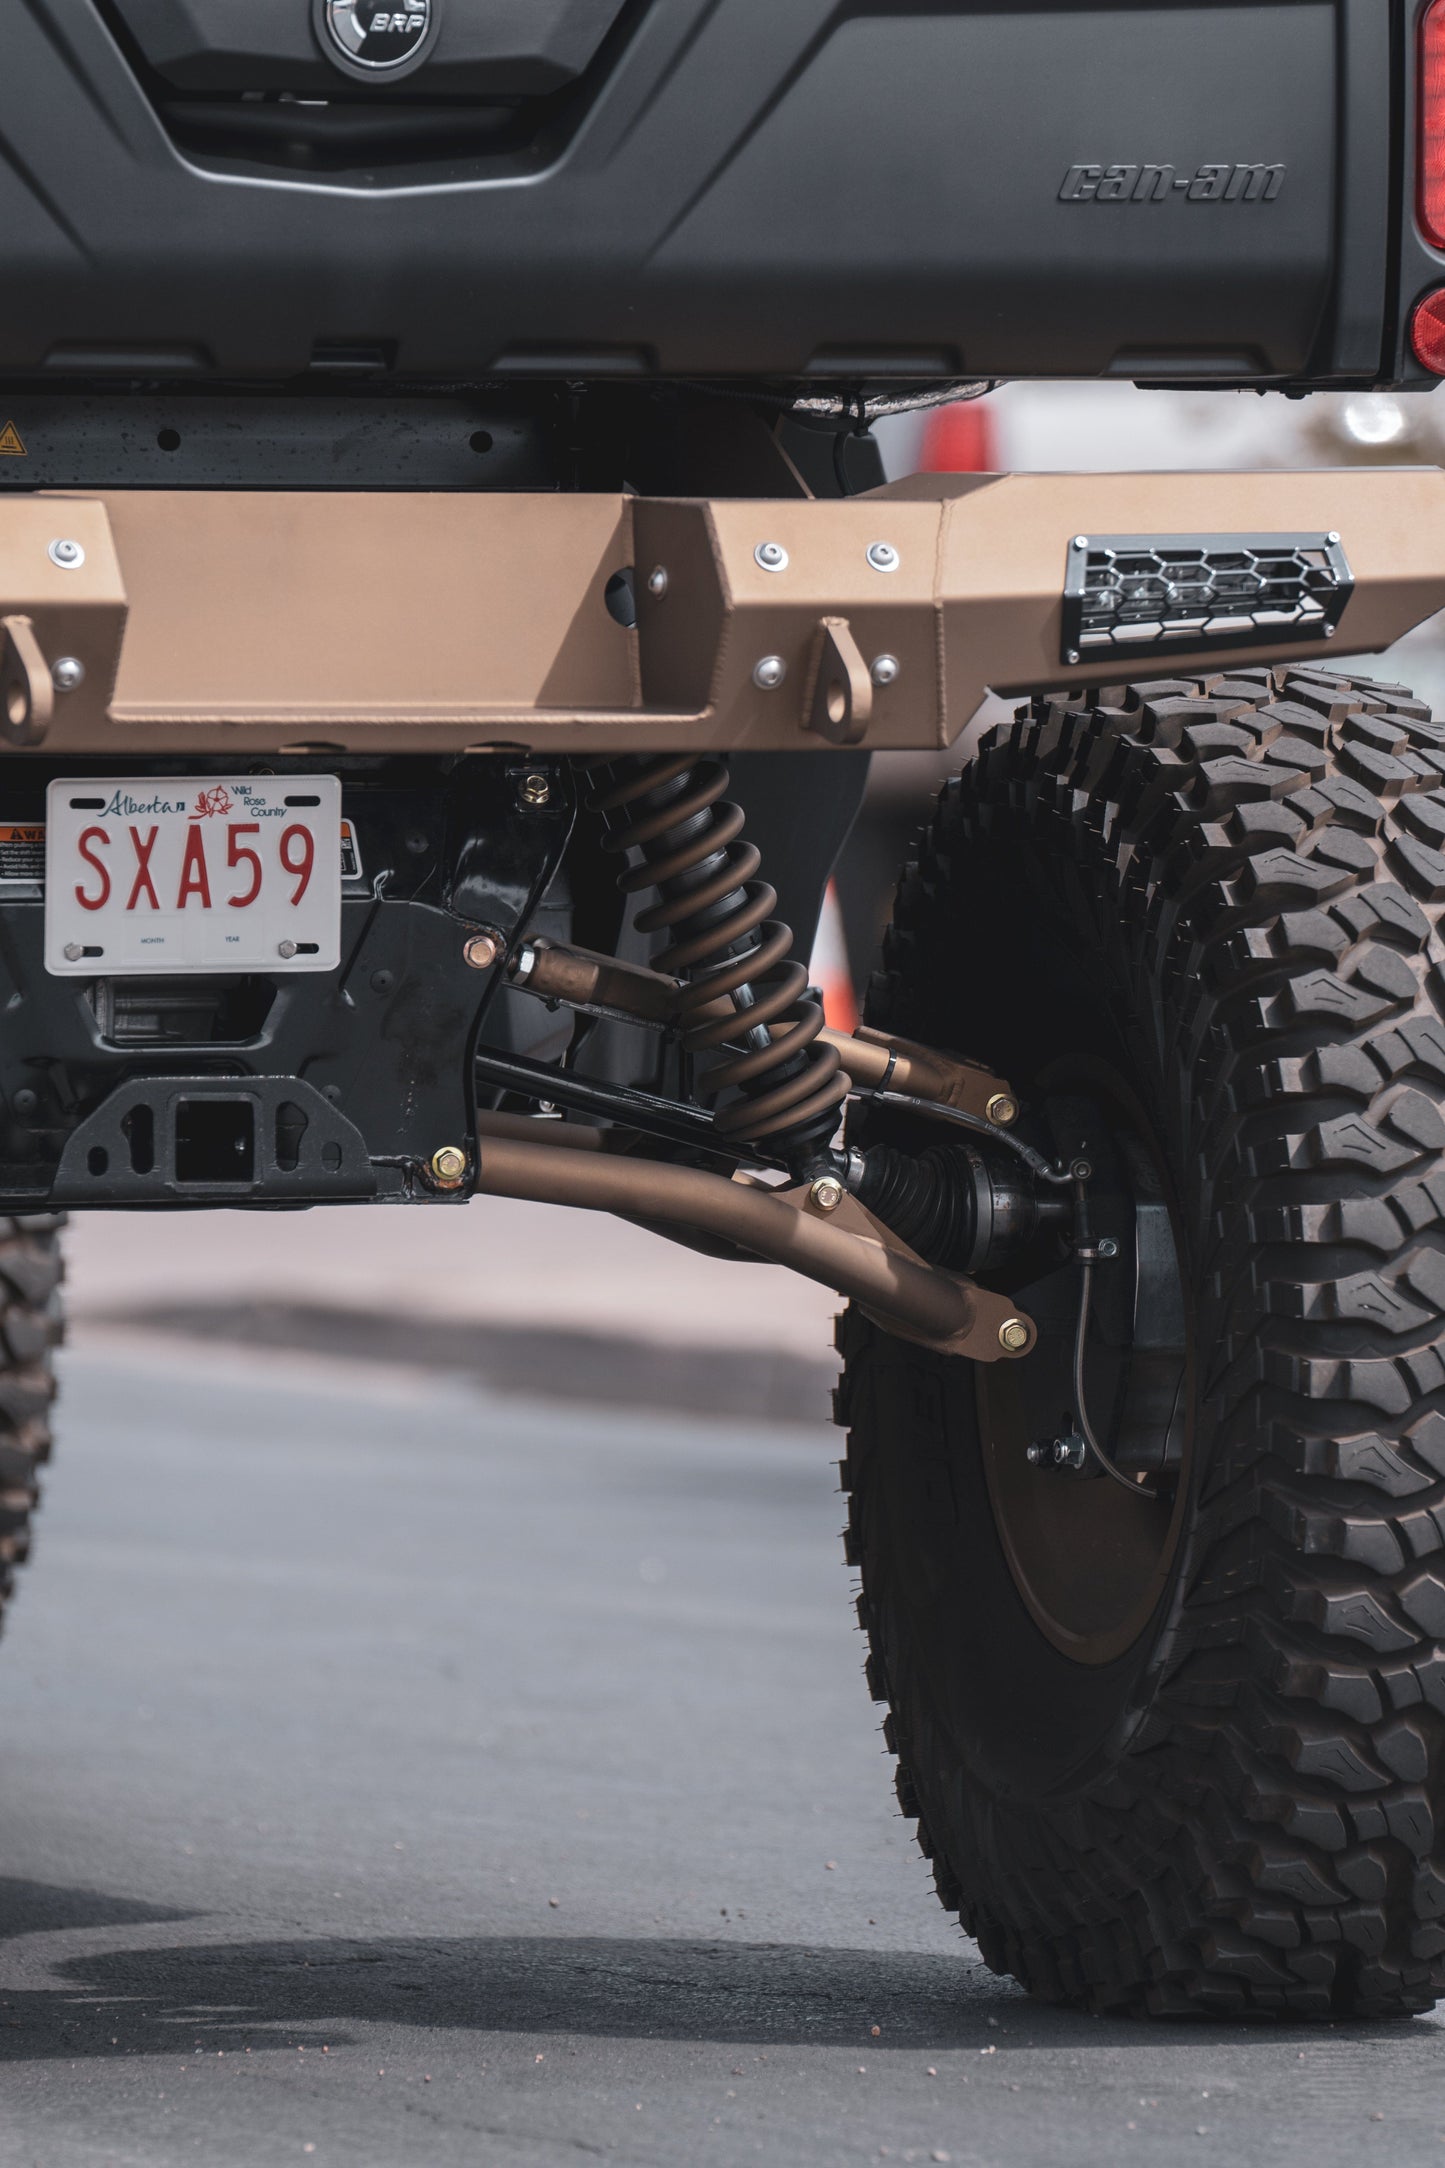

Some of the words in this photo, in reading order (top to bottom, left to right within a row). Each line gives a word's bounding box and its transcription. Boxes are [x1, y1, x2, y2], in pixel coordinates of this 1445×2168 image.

[369, 12, 425, 33] BRP
[231, 785, 253, 796] Wild
[97, 789, 176, 817] Alberta
[243, 797, 267, 806] Rose
[250, 806, 288, 818] Country
[74, 822, 315, 912] SXA59
[140, 937, 165, 945] MONTH
[225, 935, 240, 943] YEAR
